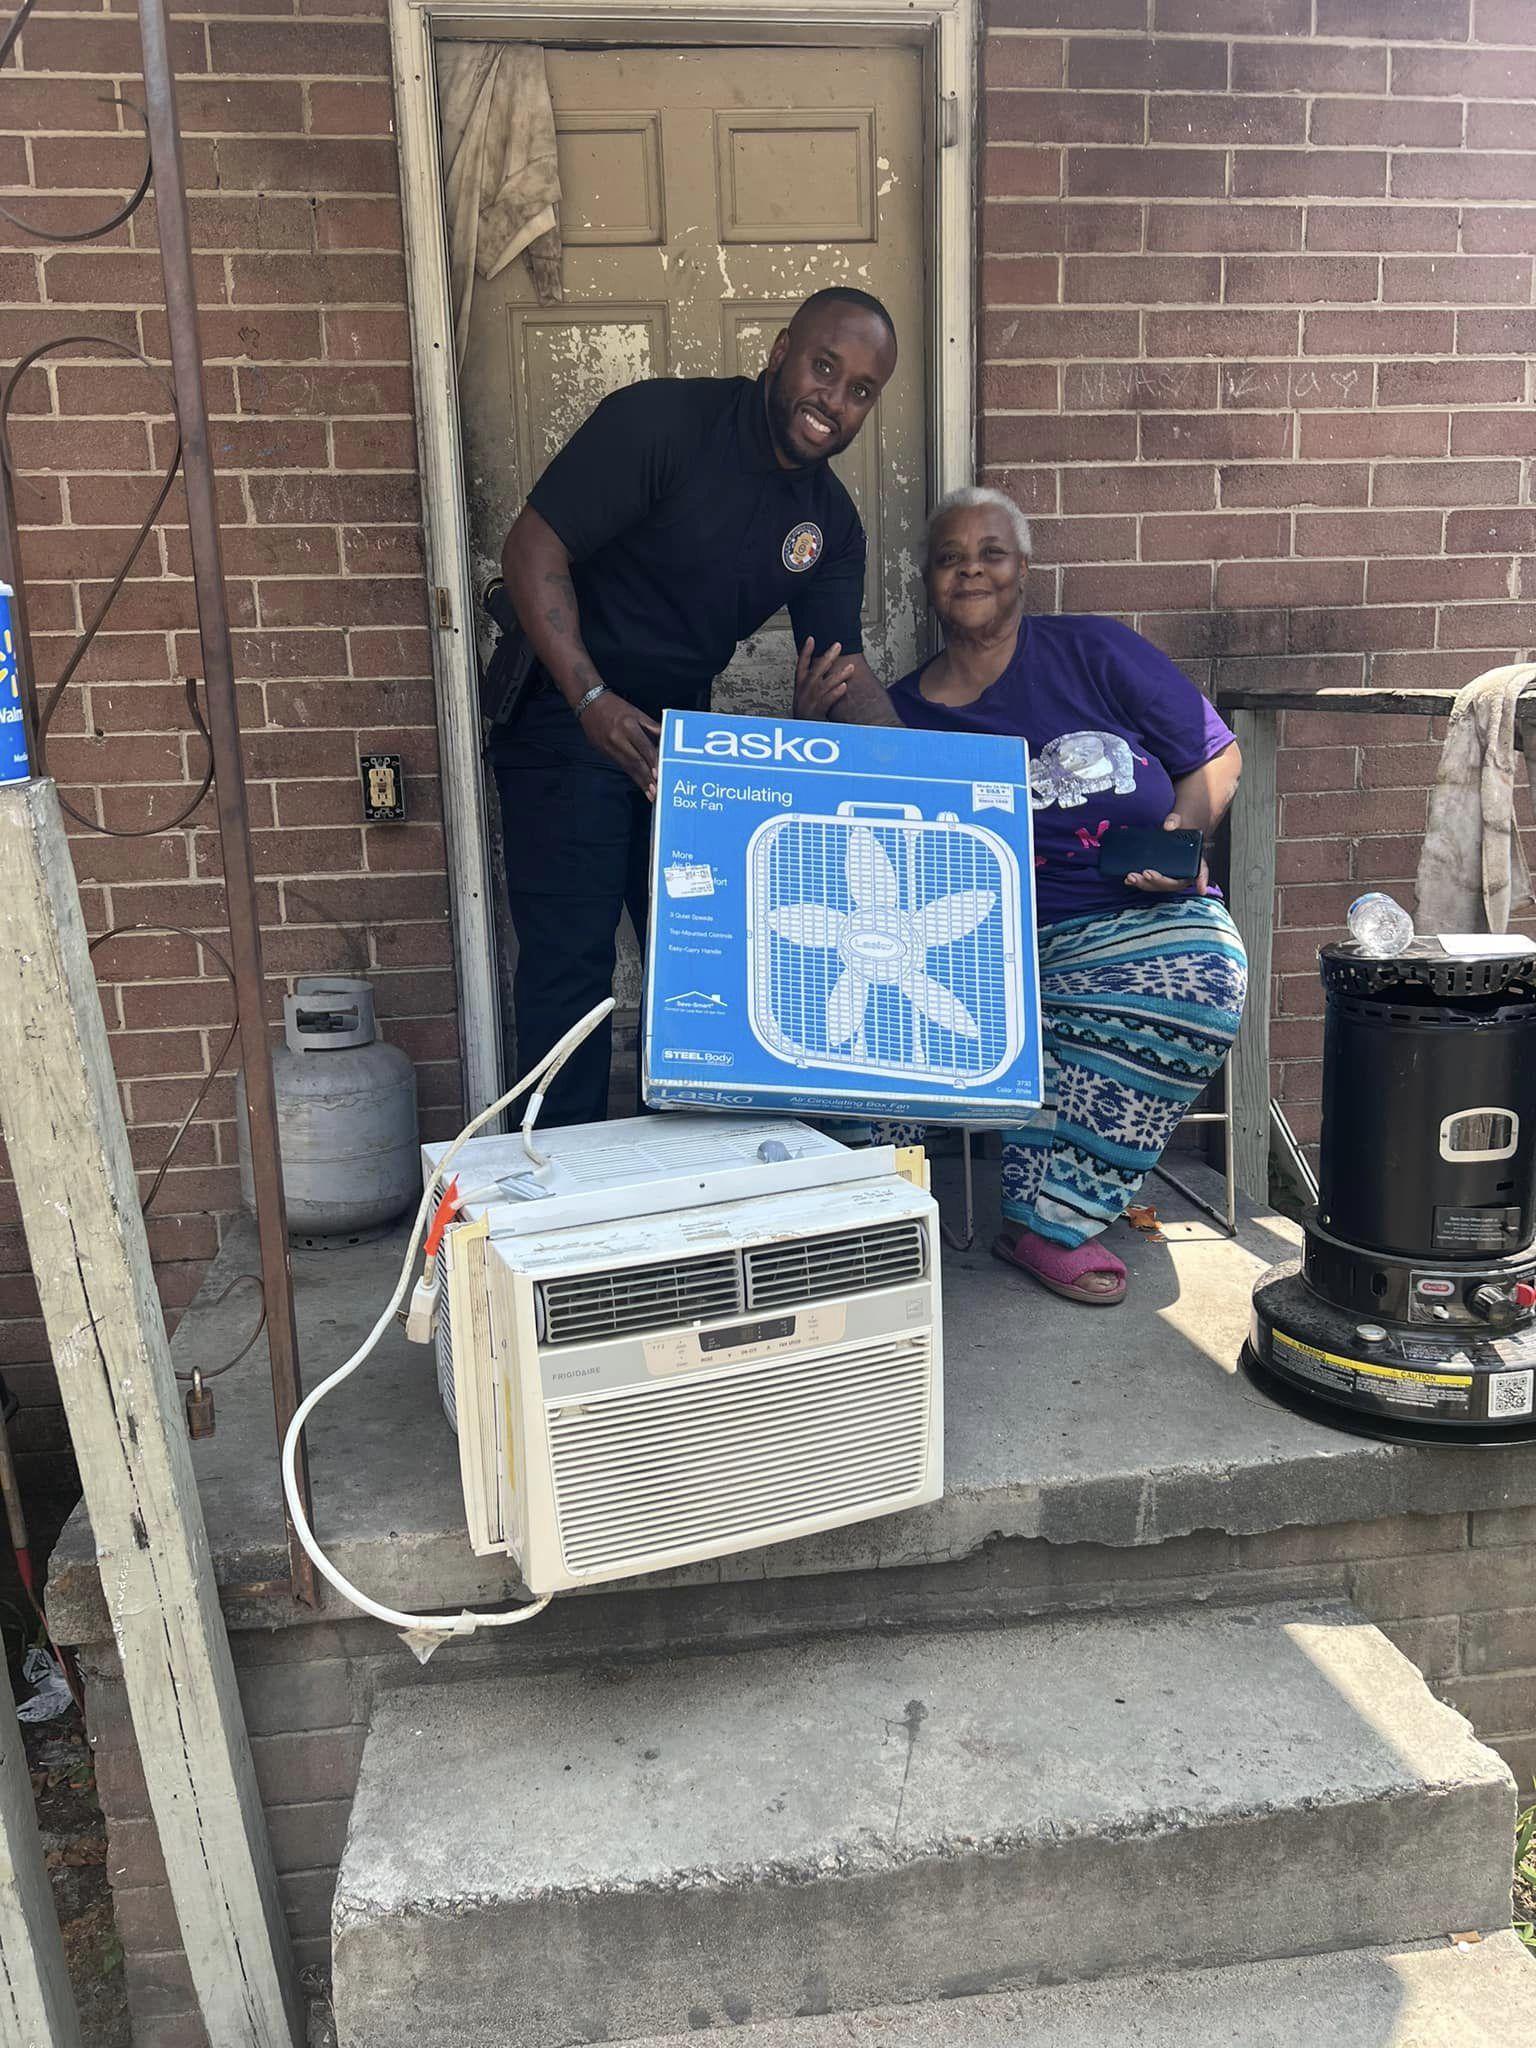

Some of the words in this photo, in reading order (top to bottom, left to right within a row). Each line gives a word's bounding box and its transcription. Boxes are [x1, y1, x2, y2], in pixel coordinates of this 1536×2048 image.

[674, 719, 841, 764] Lasko
[673, 779, 697, 795] Air
[702, 782, 793, 807] Circulating
[673, 796, 697, 809] Box
[701, 799, 723, 811] Fan
[672, 850, 693, 860] More
[664, 1050, 704, 1061] STEEL
[704, 1052, 732, 1064] Body
[661, 1088, 753, 1104] Lasko
[807, 1096, 863, 1107] Circulating
[552, 1366, 600, 1381] FRIGIDAIRE
[1400, 1370, 1437, 1382] CAUTION
